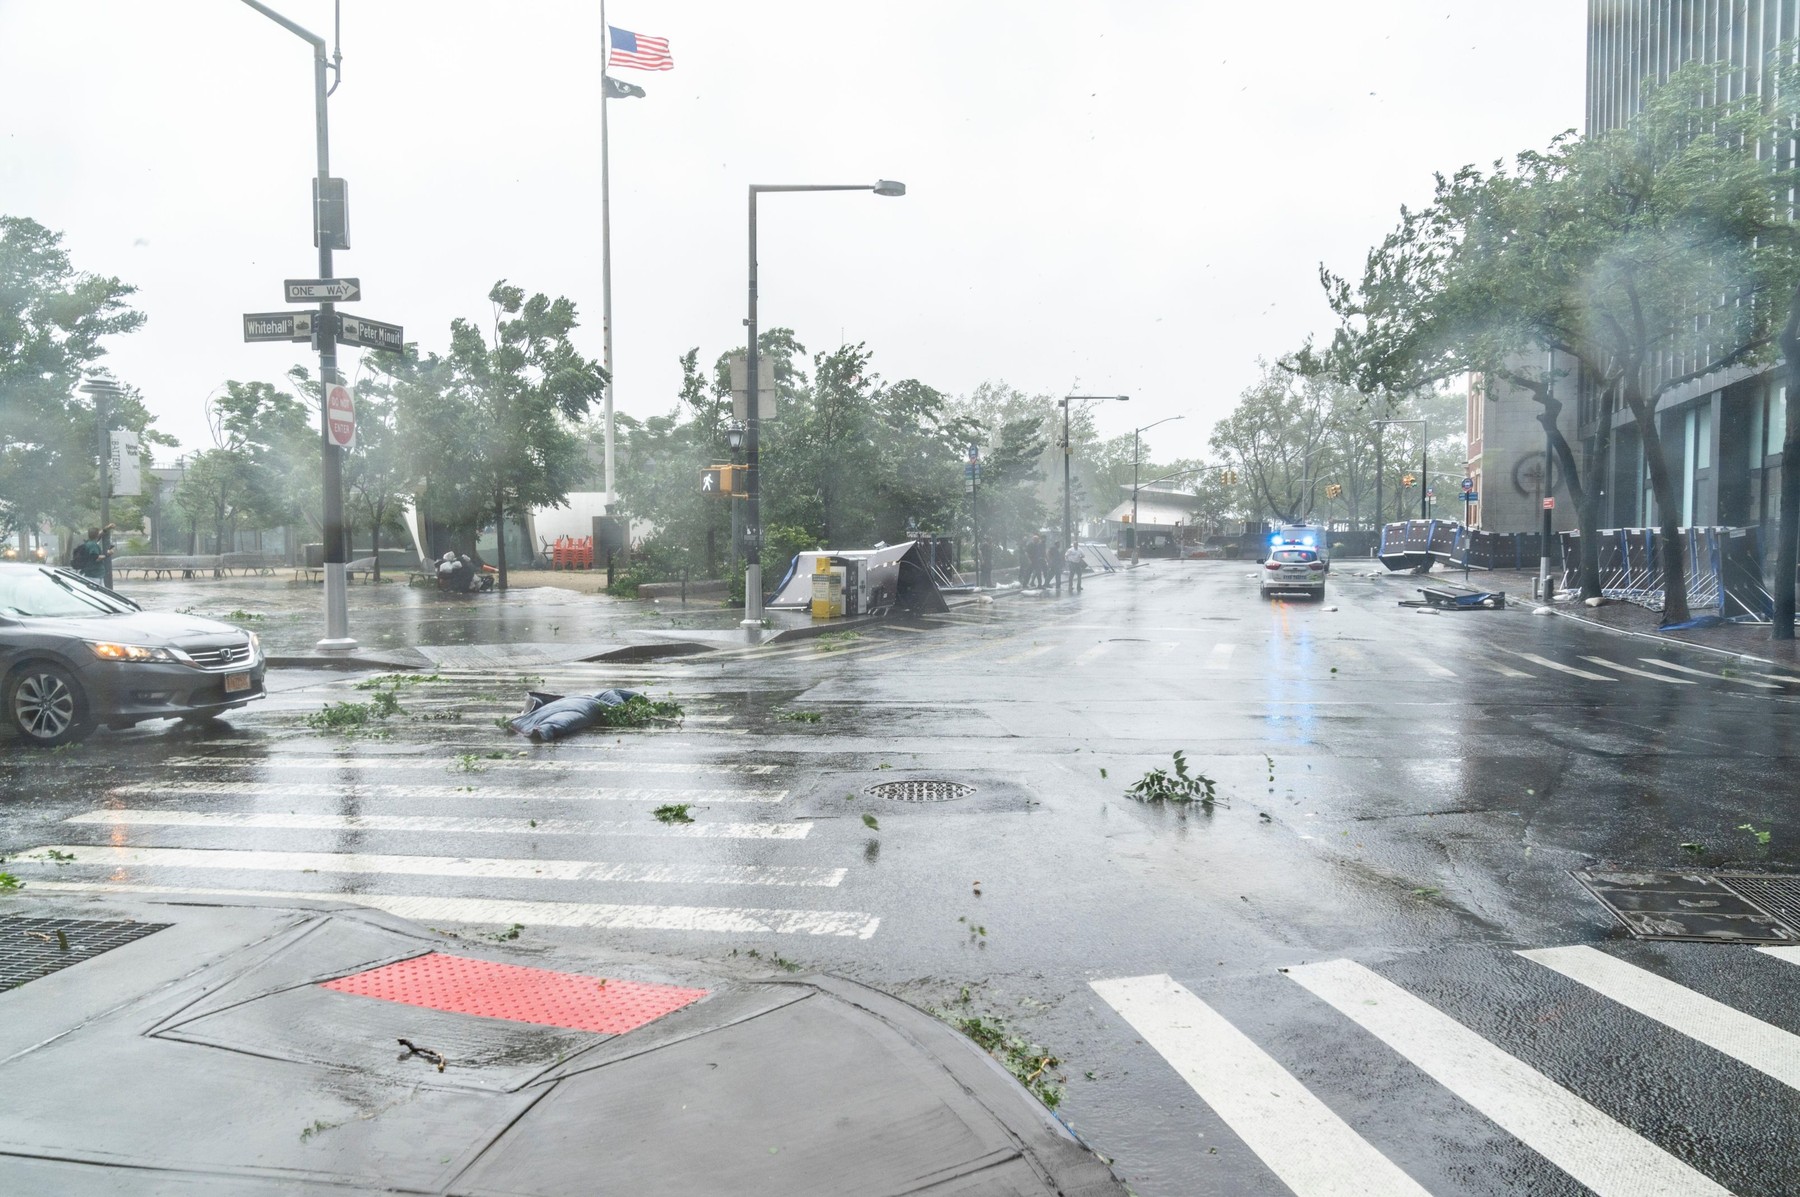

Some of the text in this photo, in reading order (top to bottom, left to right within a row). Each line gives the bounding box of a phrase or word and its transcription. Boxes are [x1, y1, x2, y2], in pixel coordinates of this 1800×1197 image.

[292, 285, 350, 296] ONE WAY
[247, 319, 293, 335] Whitehall St
[359, 323, 400, 345] Peter Minuit
[331, 396, 350, 409] DO NOT
[334, 423, 350, 434] ENTER
[111, 441, 121, 471] BATTERY
